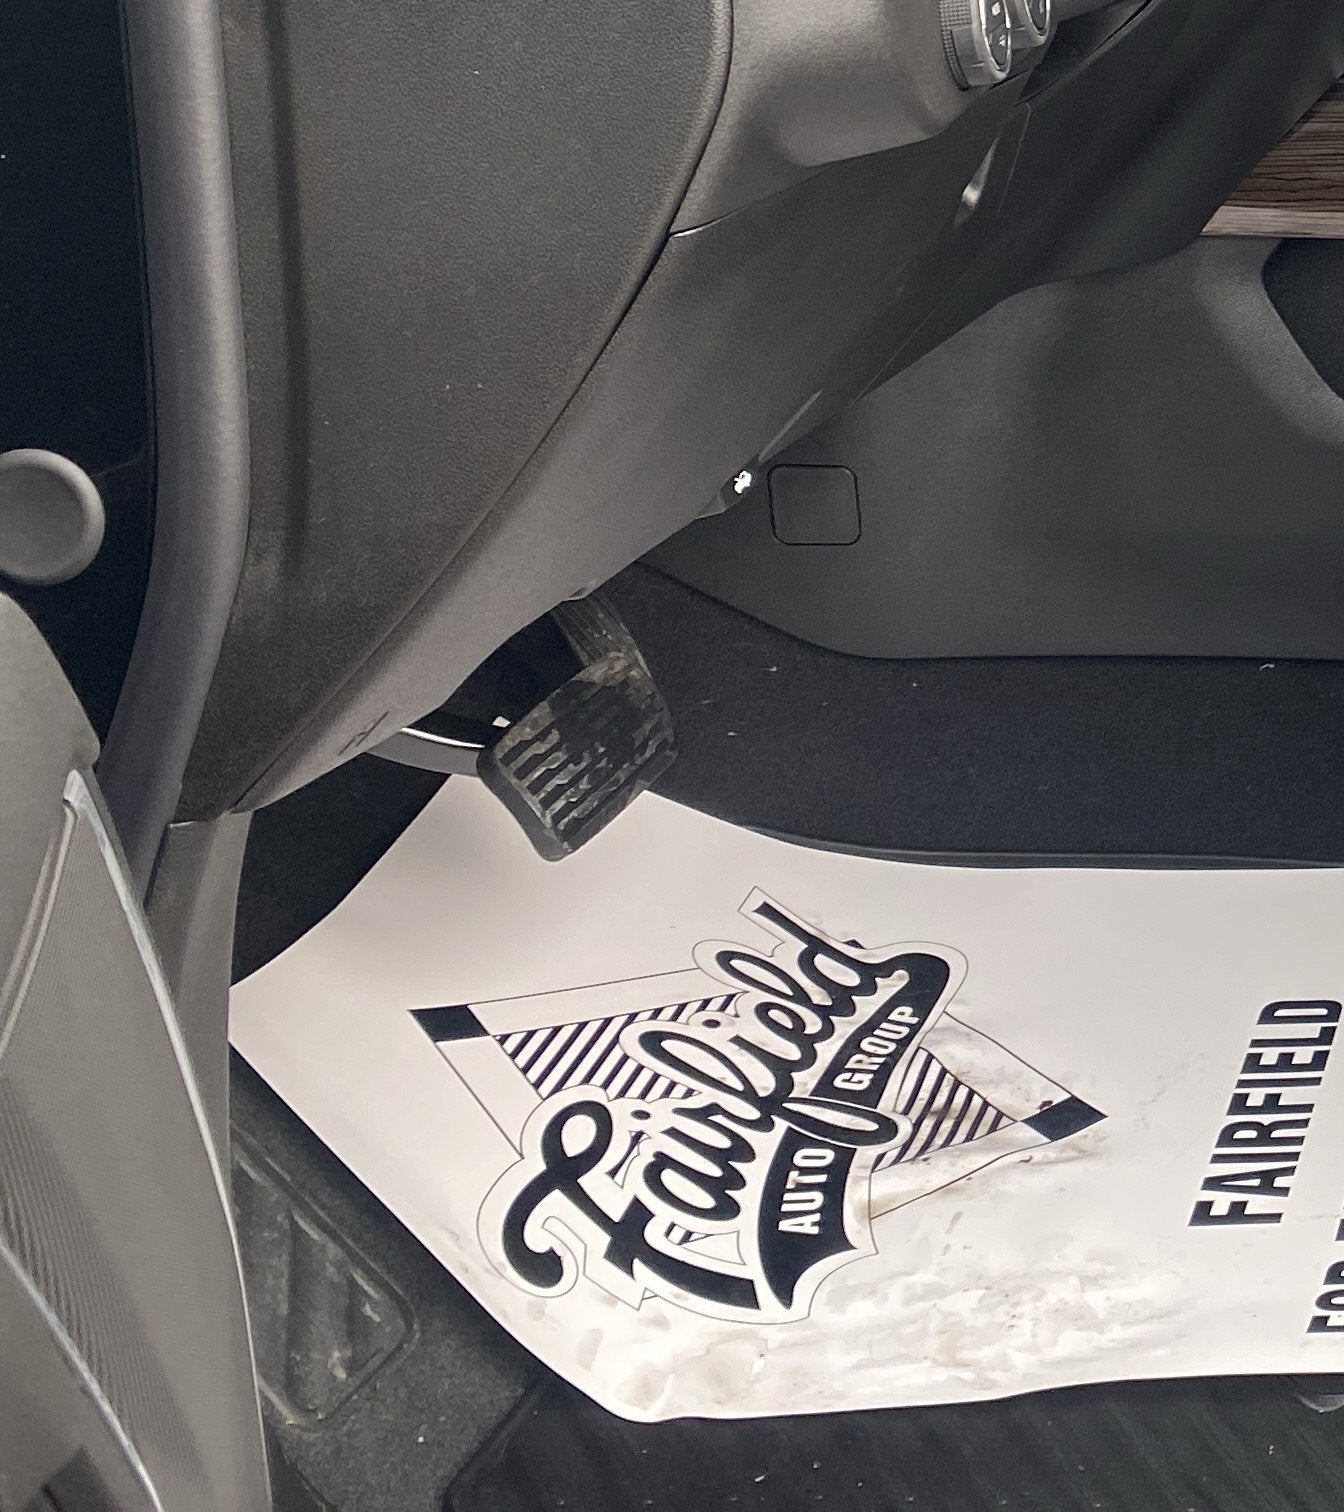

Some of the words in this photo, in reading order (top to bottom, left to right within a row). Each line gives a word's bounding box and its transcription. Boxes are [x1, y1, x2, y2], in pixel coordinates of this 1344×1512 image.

[502, 901, 949, 1310] Fairfield
[777, 1147, 837, 1236] AUTO
[832, 1004, 920, 1092] GROUP
[1187, 999, 1343, 1228] FAIRFIELD
